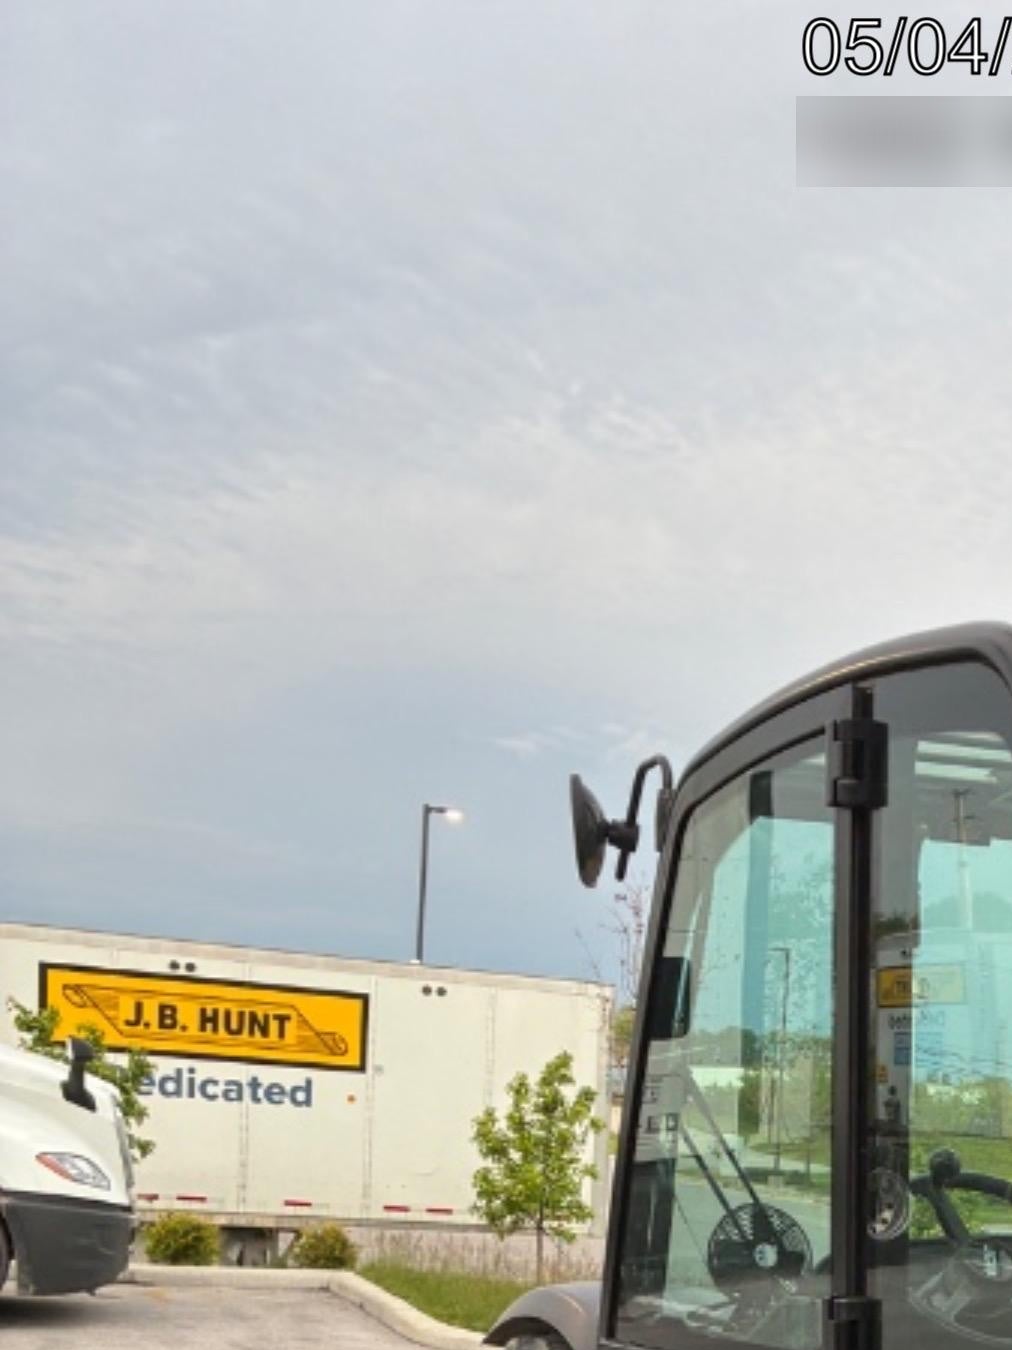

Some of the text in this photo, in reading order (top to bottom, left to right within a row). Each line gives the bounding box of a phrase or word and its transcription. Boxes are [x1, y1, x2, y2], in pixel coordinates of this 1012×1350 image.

[125, 1001, 292, 1040] J. B. HUNT
[128, 1066, 313, 1108] edicated
